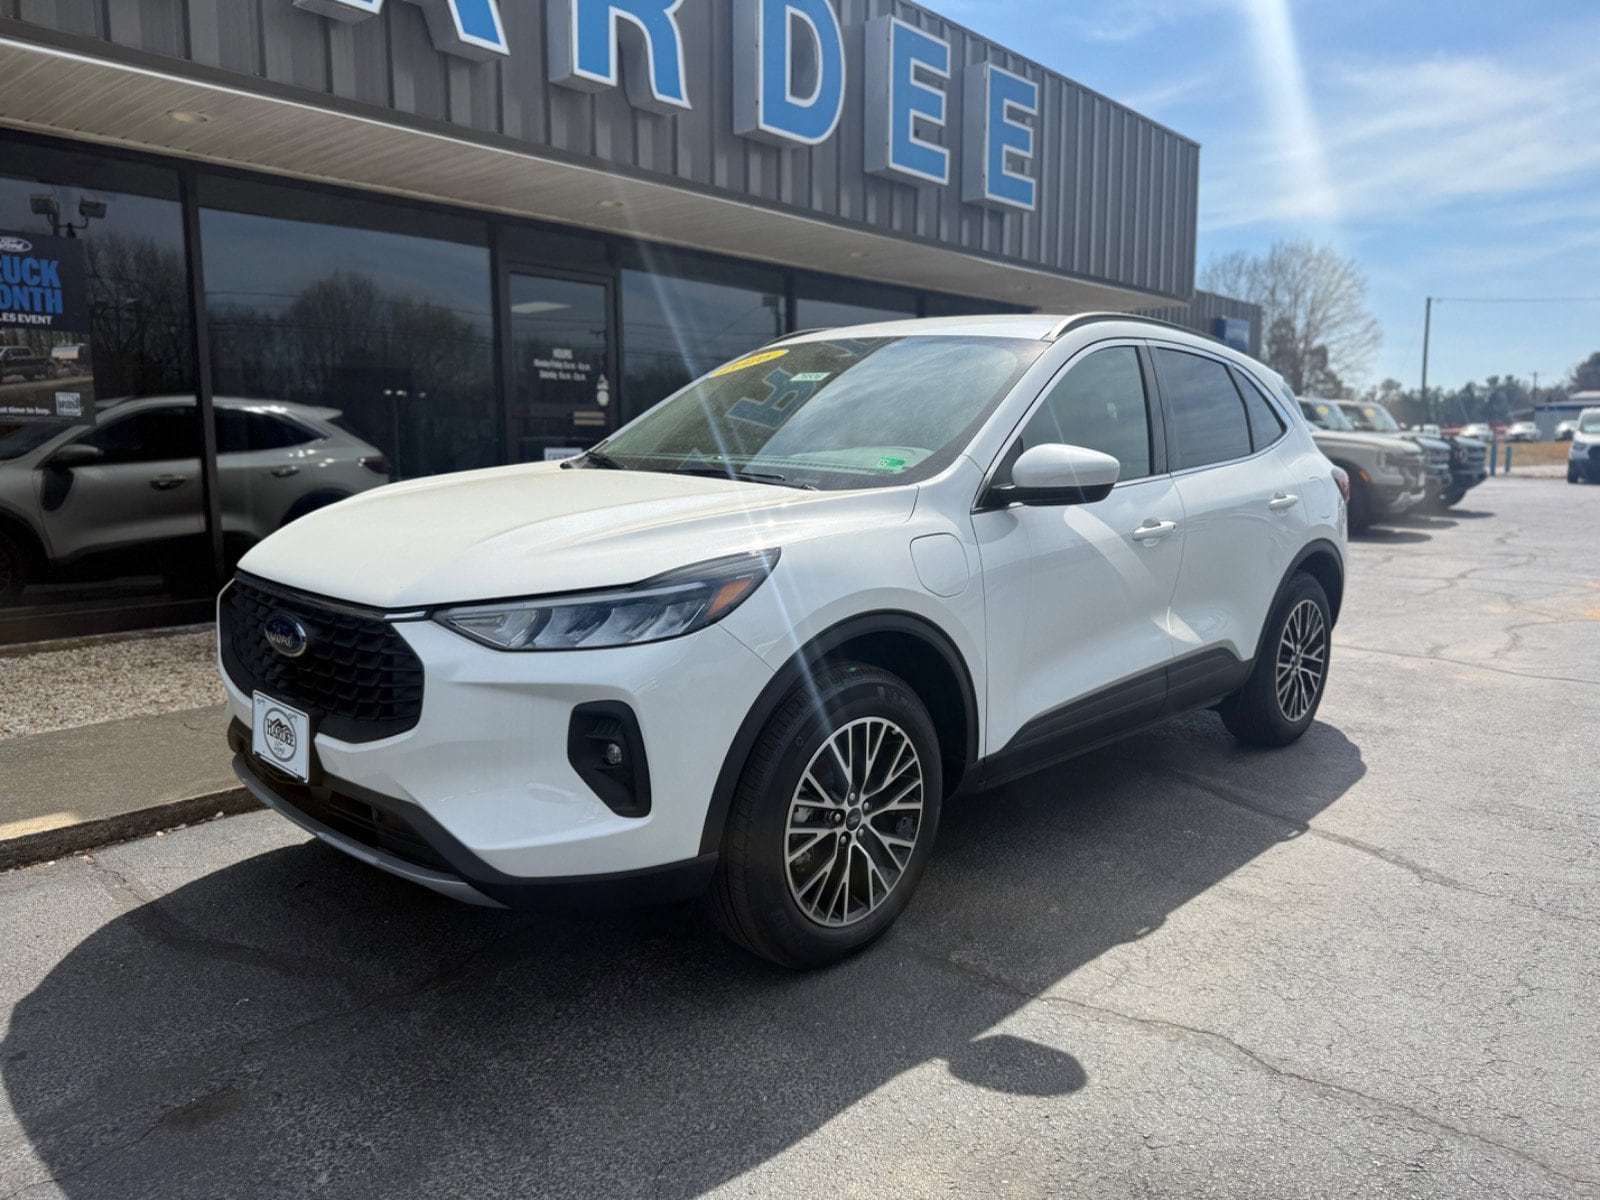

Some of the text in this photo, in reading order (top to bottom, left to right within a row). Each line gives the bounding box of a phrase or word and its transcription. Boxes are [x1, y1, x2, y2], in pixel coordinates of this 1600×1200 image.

[307, 0, 1038, 210] RDEE
[0, 254, 61, 288] UCK
[18, 313, 53, 325] EVENT
